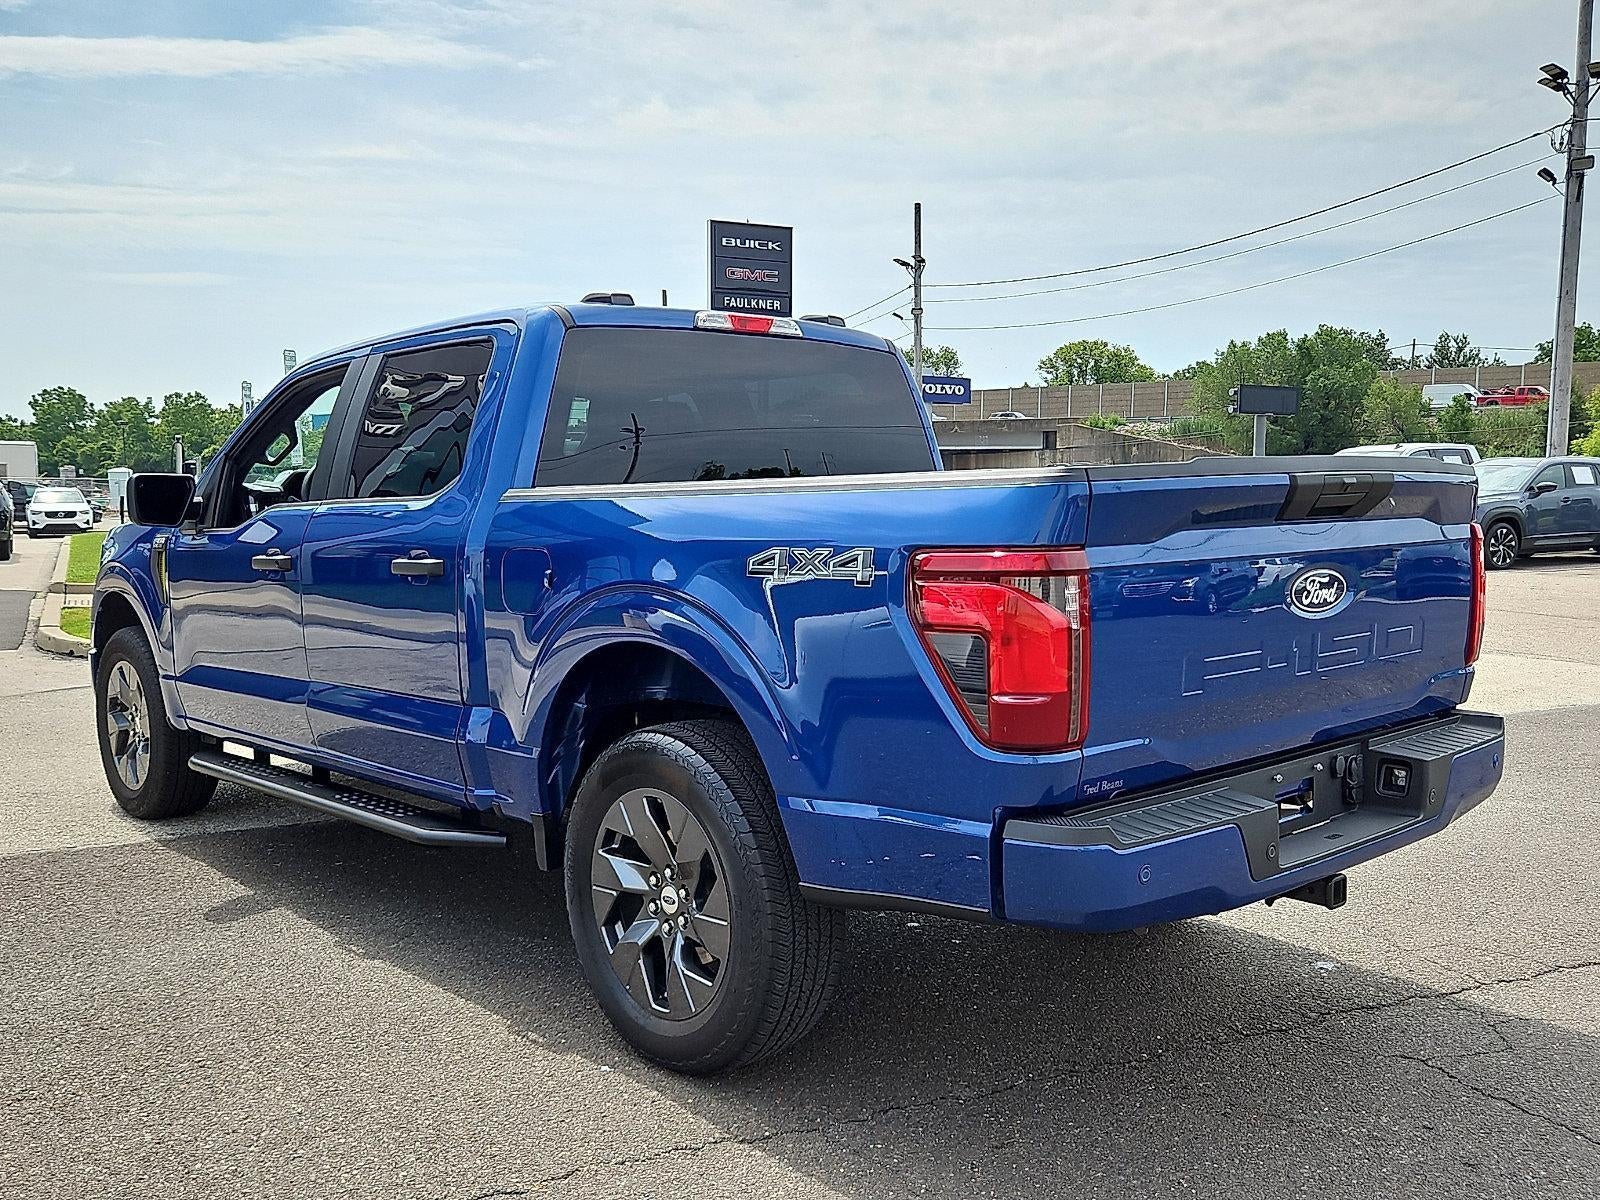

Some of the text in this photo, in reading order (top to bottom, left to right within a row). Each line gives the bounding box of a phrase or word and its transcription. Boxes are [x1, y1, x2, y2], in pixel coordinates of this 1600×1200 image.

[721, 237, 783, 251] BUICK
[726, 267, 779, 282] GMC
[724, 296, 781, 310] FAULKNER
[746, 547, 875, 587] 4X4
[1302, 576, 1338, 605] Ford
[1182, 616, 1425, 696] F-150
[1101, 780, 1123, 791] Beans
